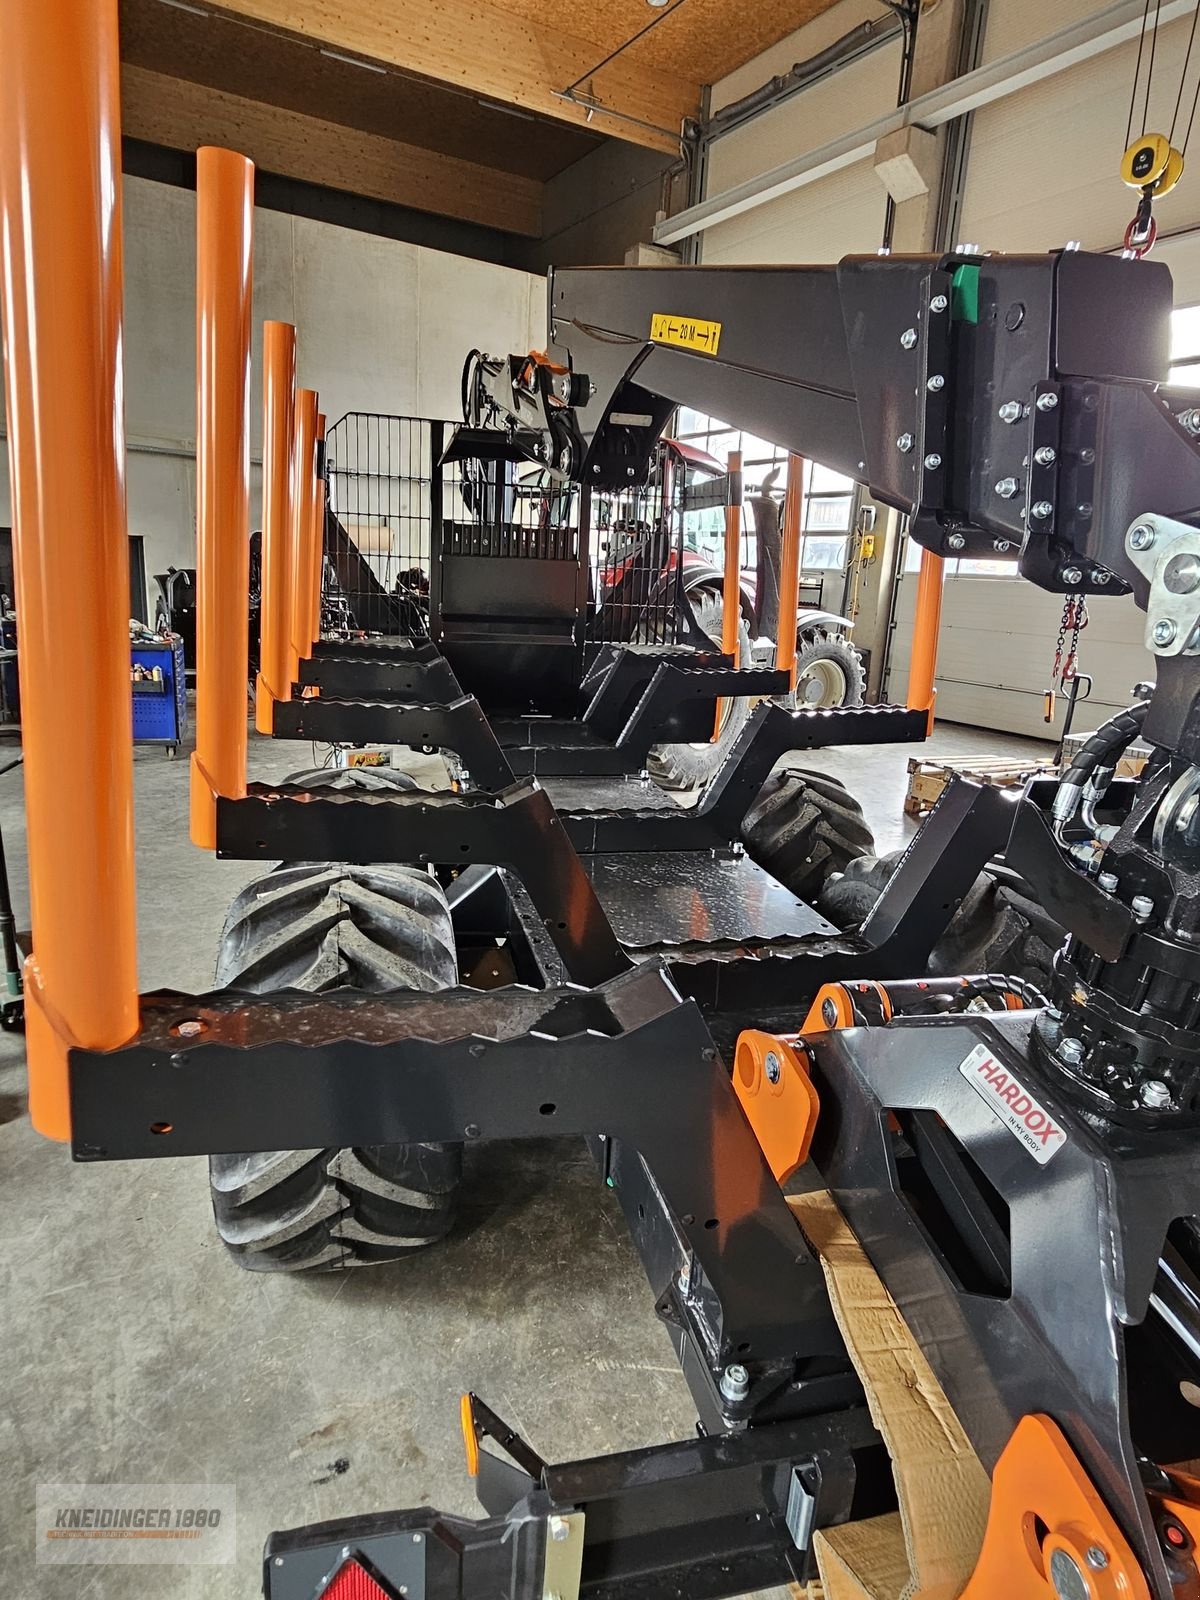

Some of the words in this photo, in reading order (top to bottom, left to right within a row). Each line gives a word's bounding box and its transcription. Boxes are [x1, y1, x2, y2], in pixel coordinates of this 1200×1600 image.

[680, 324, 688, 340] 20
[689, 325, 696, 342] M
[977, 1058, 1059, 1146] HARDOX
[1008, 1116, 1016, 1127] IN
[1015, 1123, 1026, 1135] MY
[1023, 1133, 1041, 1153] BODY
